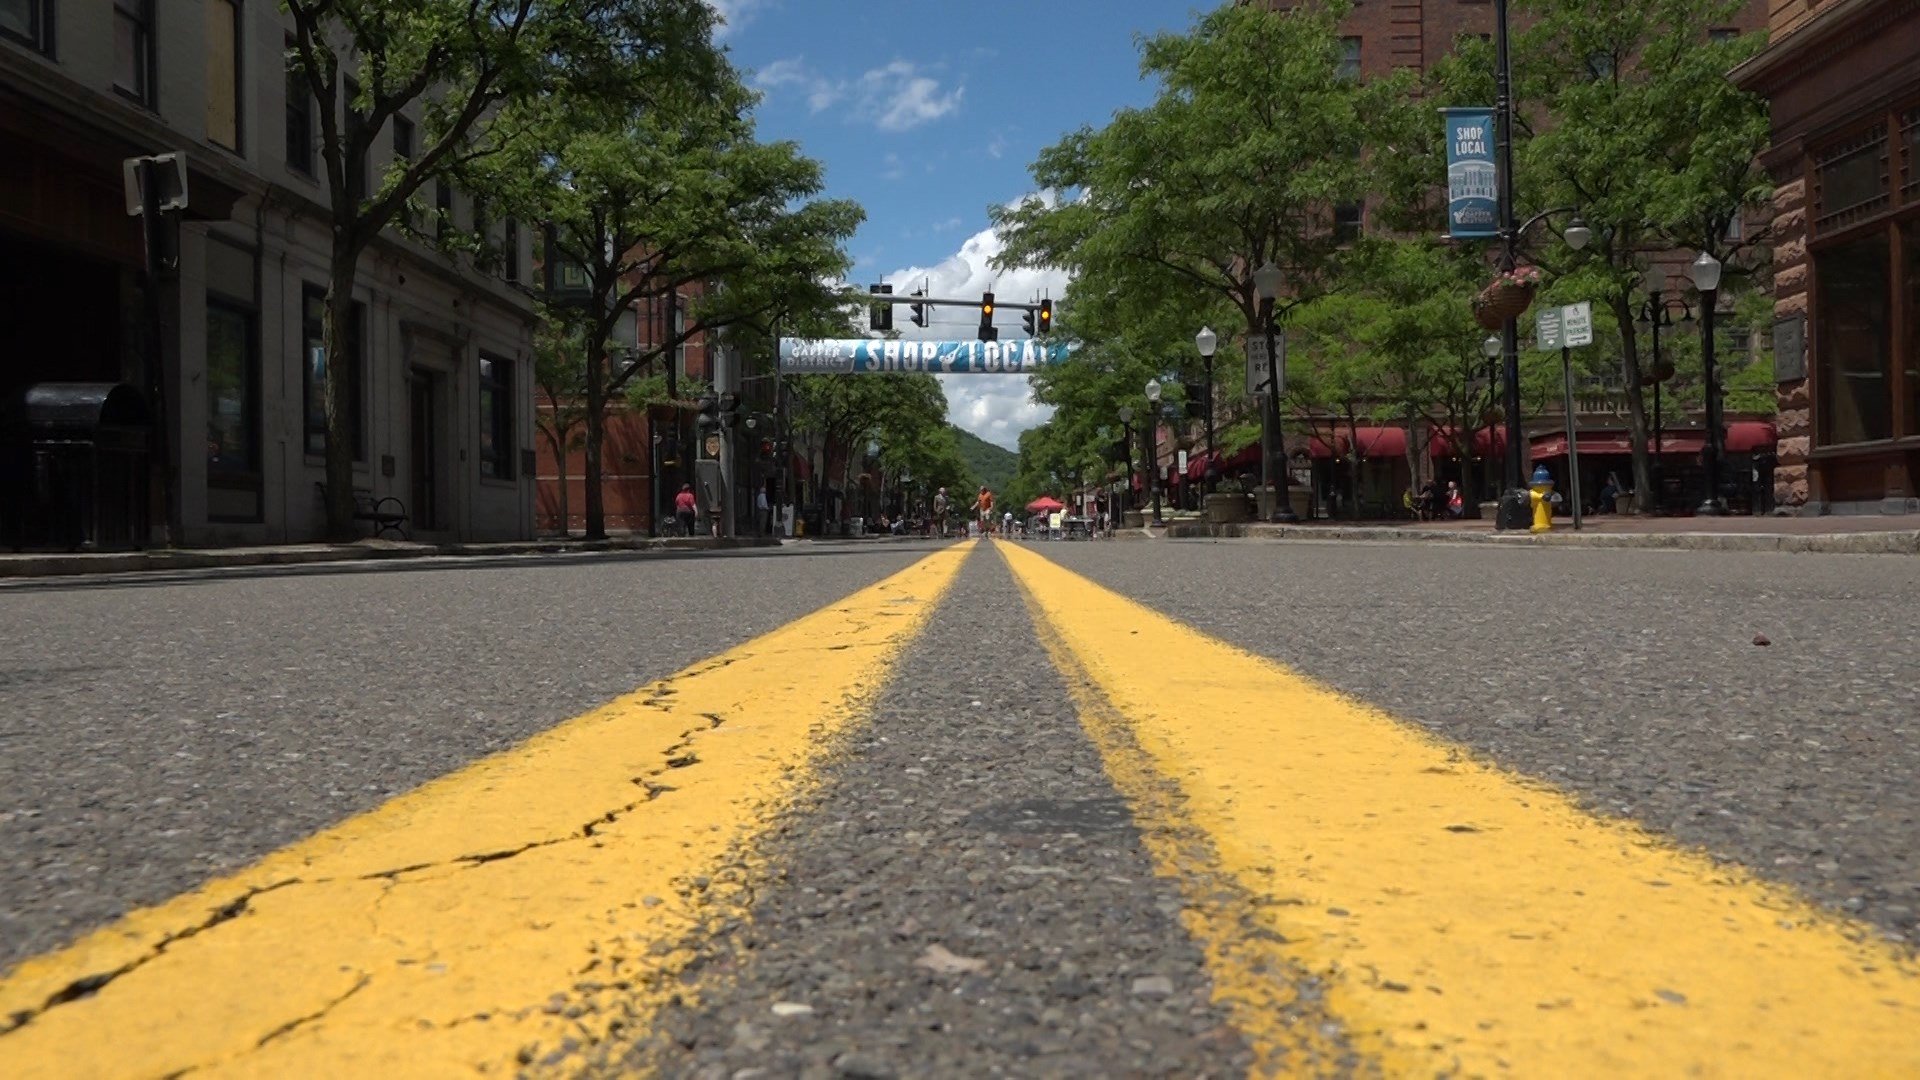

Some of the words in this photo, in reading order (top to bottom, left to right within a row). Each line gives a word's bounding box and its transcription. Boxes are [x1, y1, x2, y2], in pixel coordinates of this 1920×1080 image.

[1456, 127, 1483, 141] SHOP
[1455, 141, 1486, 156] LOCAL
[864, 339, 938, 371] SHOP
